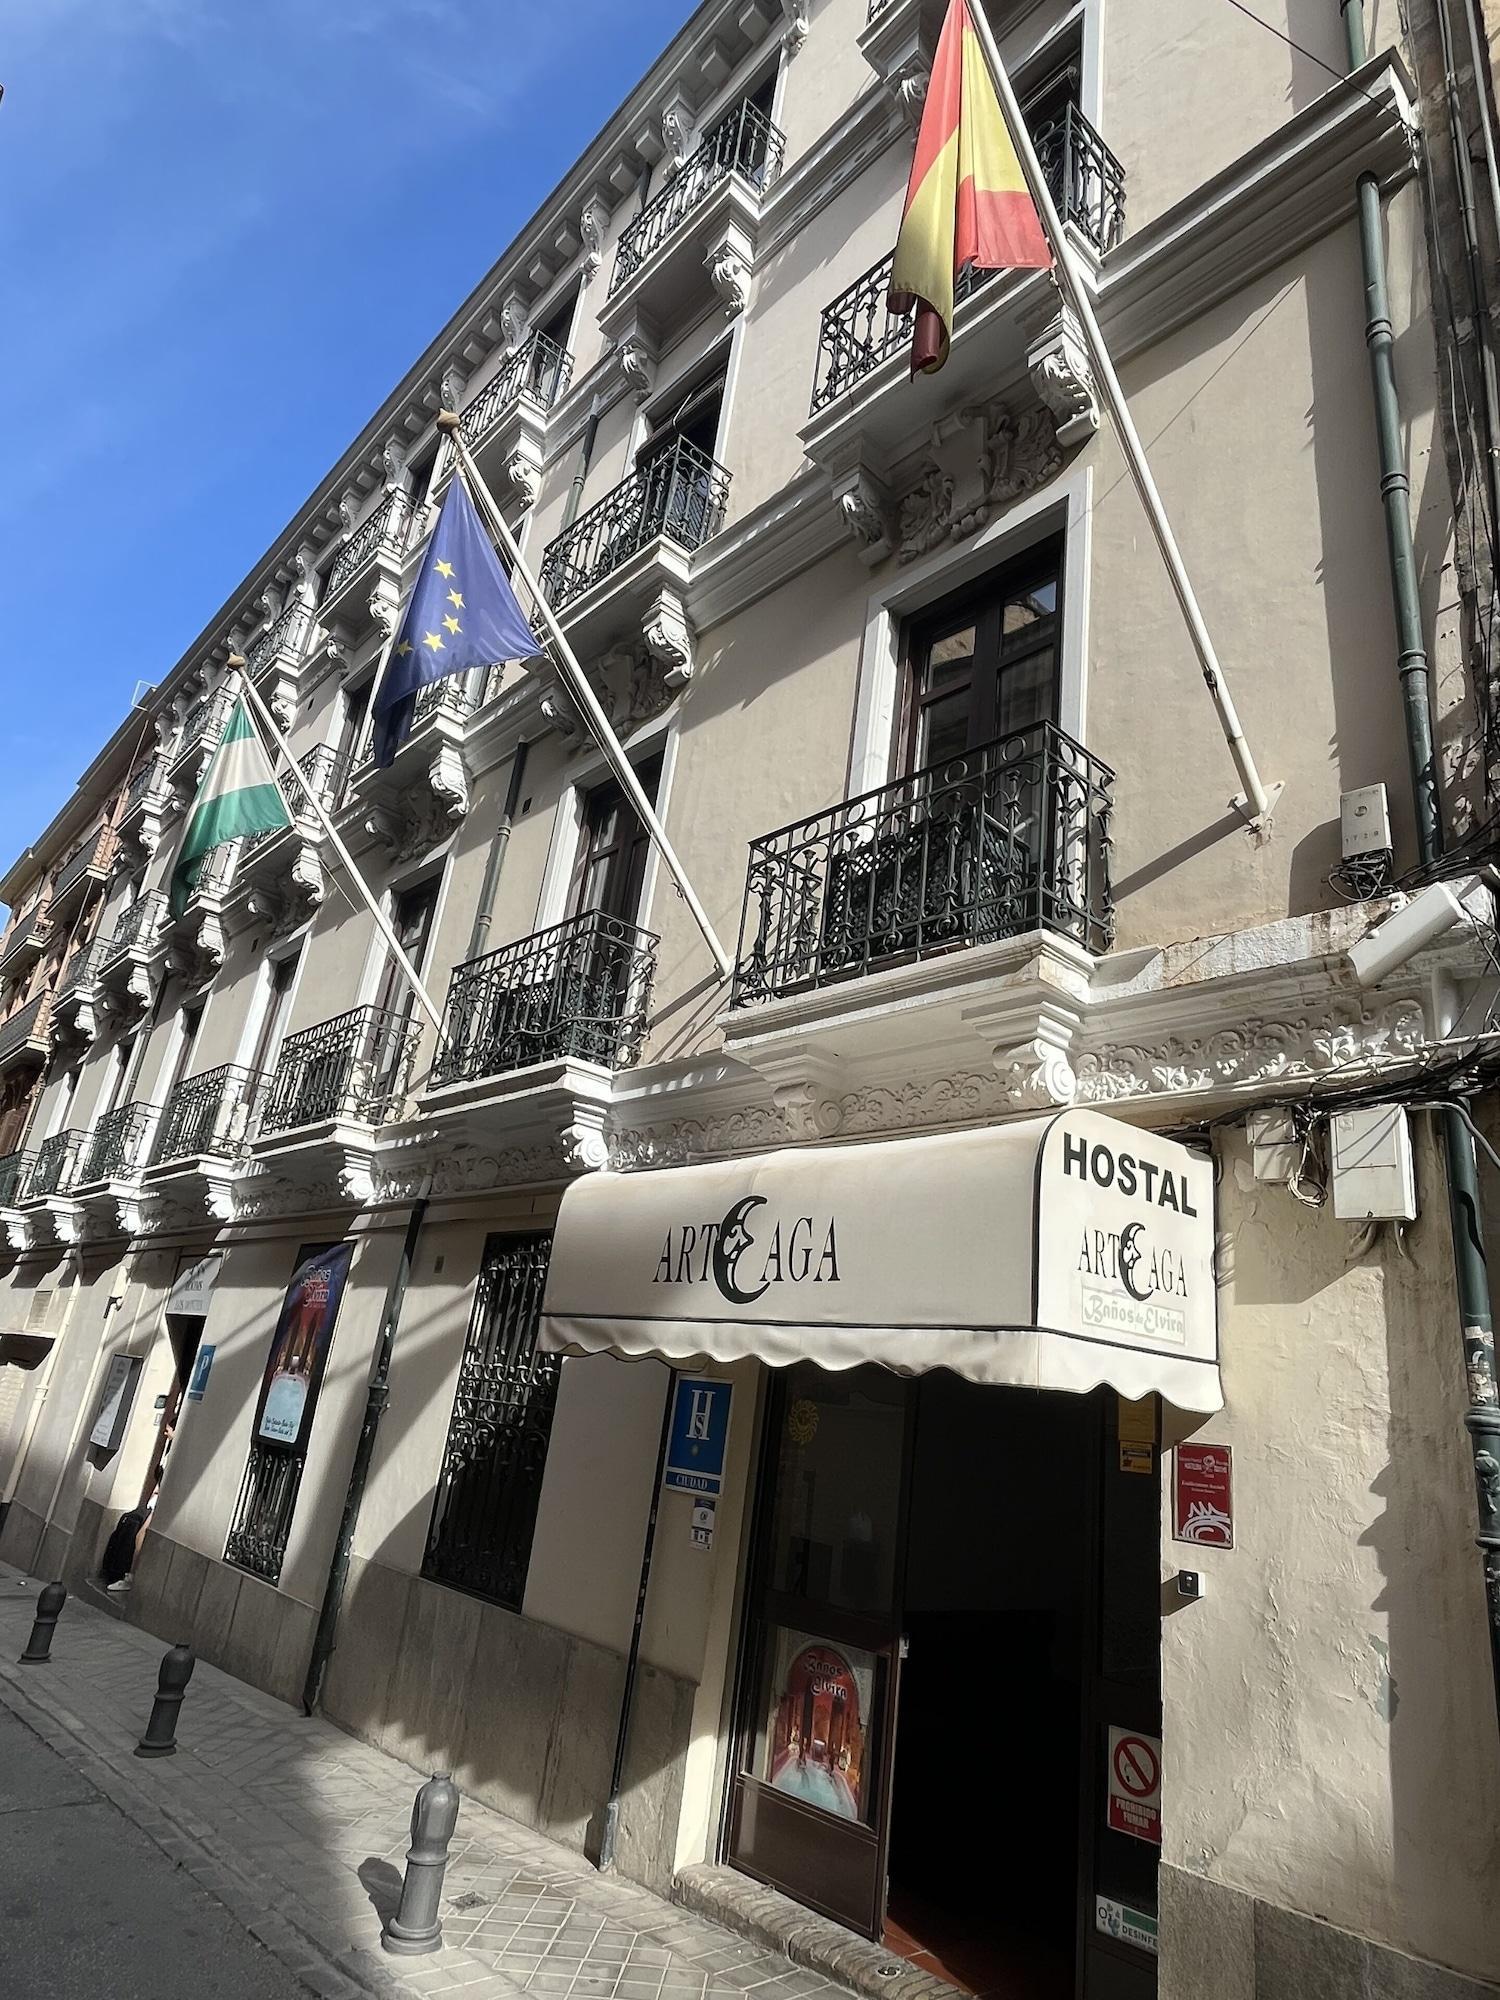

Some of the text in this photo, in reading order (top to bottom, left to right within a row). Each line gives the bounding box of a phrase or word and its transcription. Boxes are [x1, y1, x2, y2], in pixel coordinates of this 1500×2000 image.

[1063, 1131, 1198, 1218] HOSTAL
[1085, 1294, 1134, 1324] Baños
[1144, 1307, 1184, 1334] Elvira
[675, 1473, 709, 1490] CIUDAD
[1115, 1797, 1157, 1821] PROHIBIDO
[1123, 1810, 1150, 1829] FUMAR
